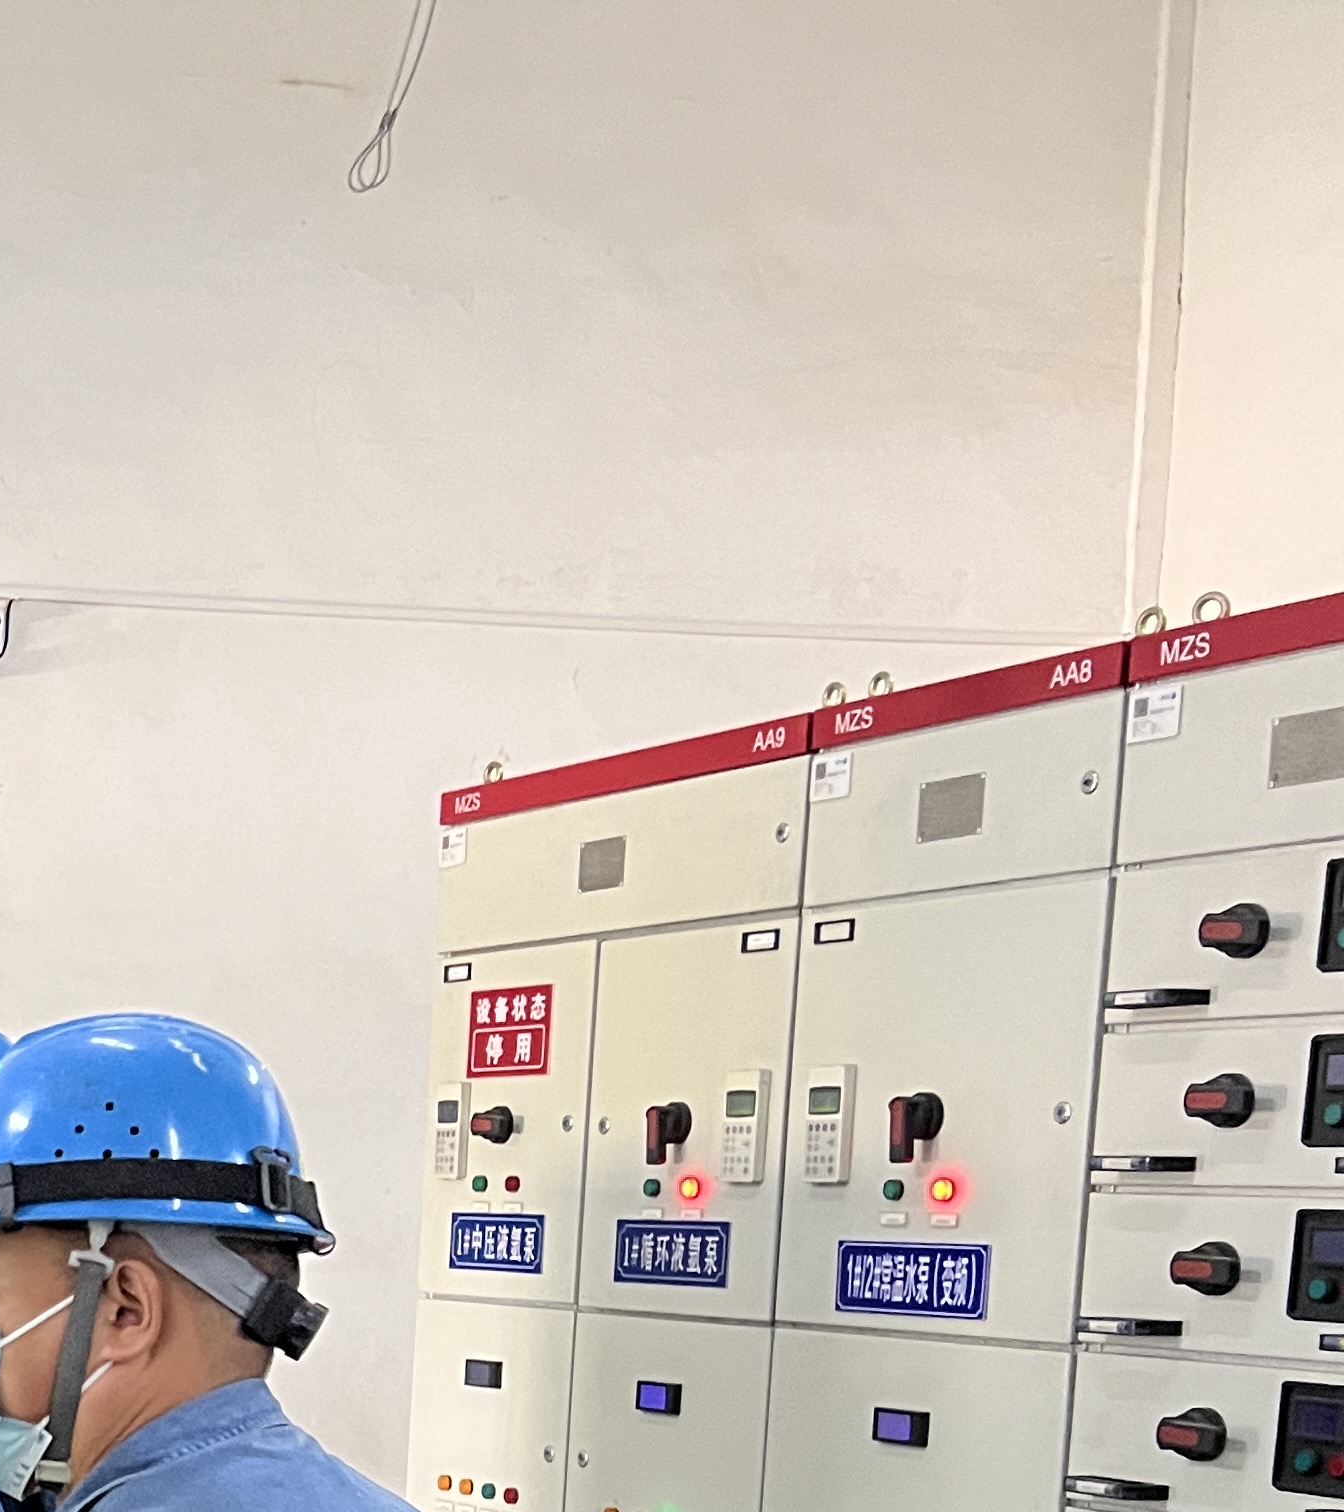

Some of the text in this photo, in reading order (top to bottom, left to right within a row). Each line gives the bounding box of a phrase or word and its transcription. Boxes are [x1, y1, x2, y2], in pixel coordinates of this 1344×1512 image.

[1160, 632, 1211, 666] MZS
[1049, 659, 1093, 690] AA8
[834, 706, 874, 735] MZS
[752, 726, 786, 753] AA9
[454, 792, 481, 814] MZS
[476, 993, 546, 1025] 设备状态
[485, 1033, 532, 1066] 停用
